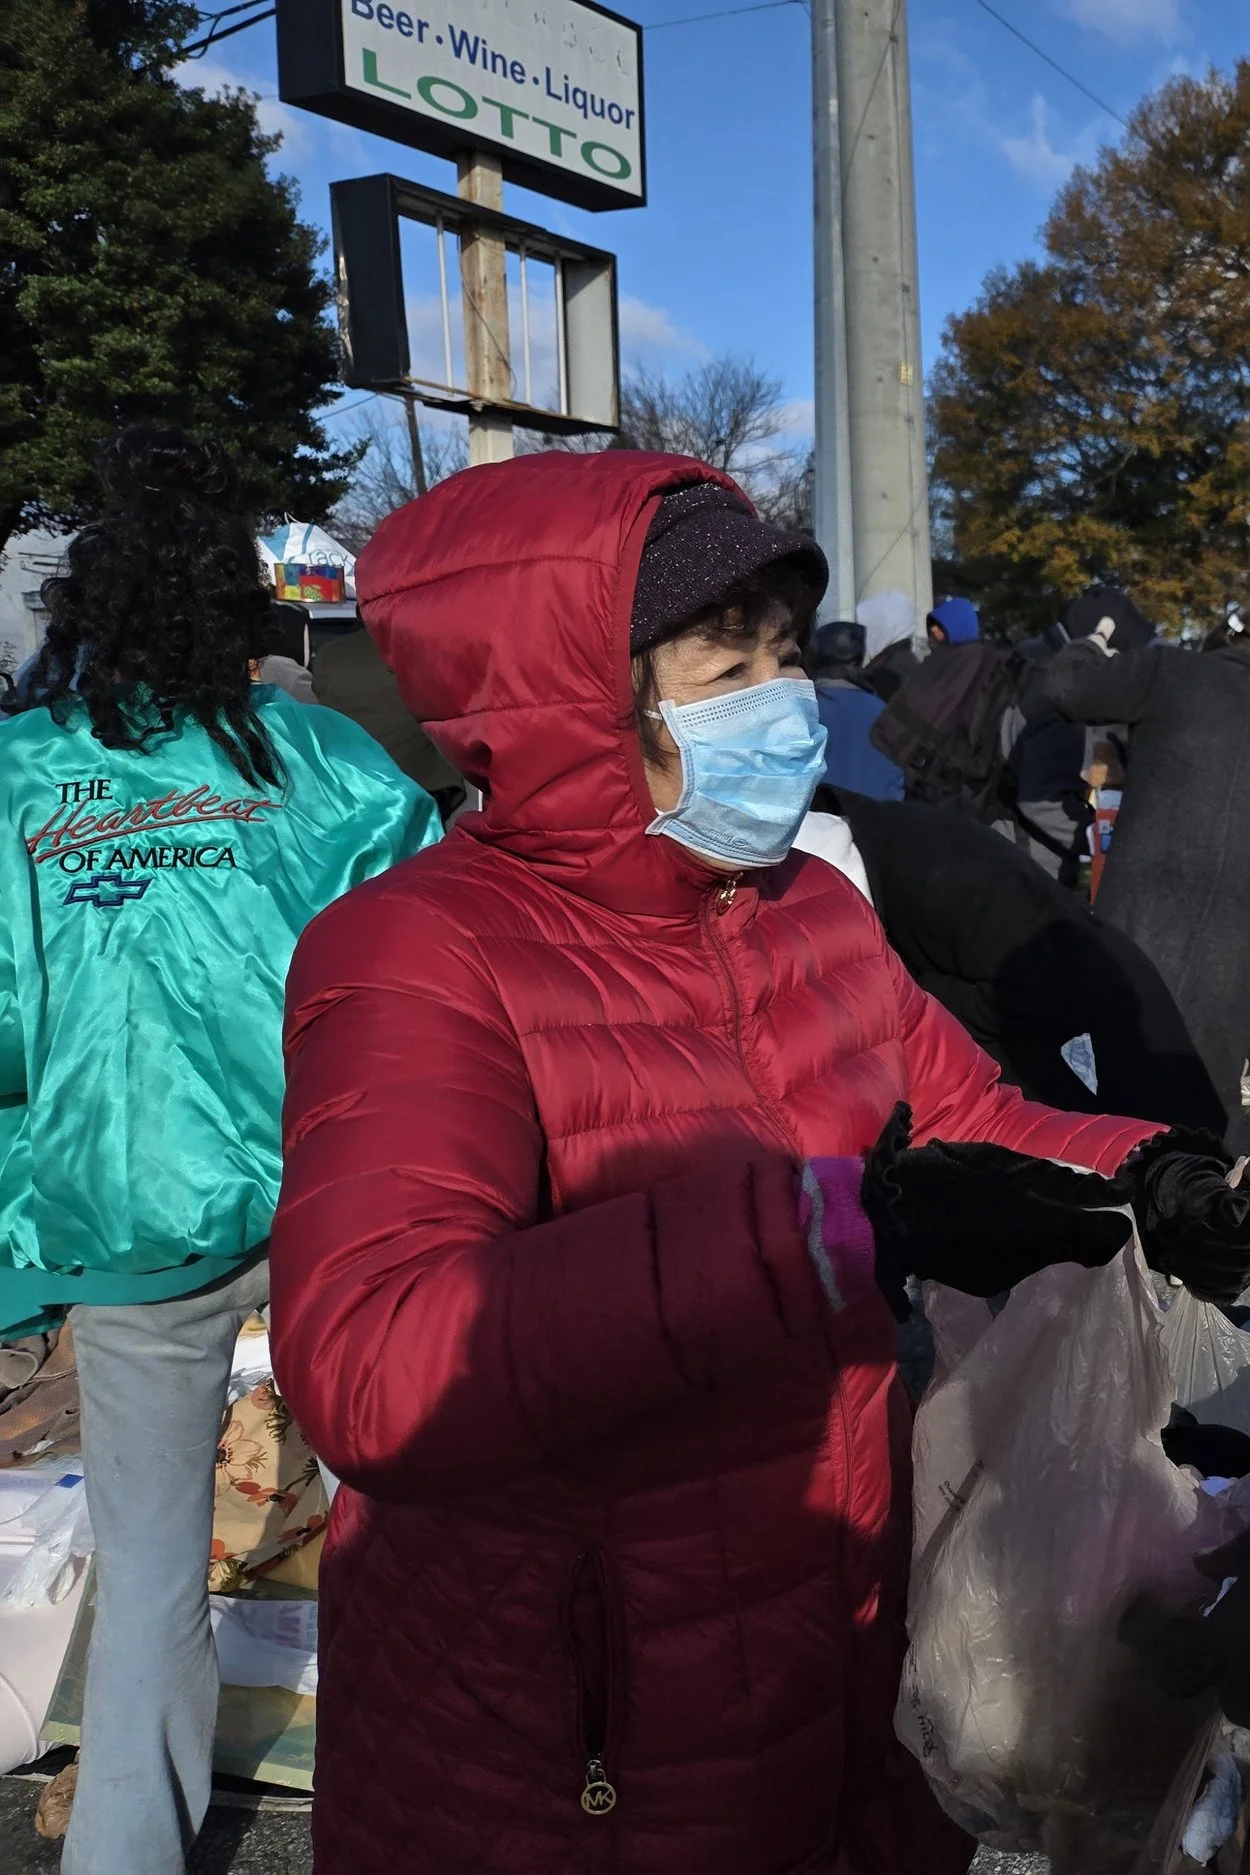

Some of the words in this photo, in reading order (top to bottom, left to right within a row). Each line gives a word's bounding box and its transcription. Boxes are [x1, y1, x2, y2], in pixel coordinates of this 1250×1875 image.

[351, 0, 430, 44] Beer
[448, 24, 526, 85] Wine
[545, 66, 635, 130] Liquor
[362, 48, 632, 180] LOTTO
[55, 779, 113, 804] THE
[26, 784, 284, 857] Heartbeat
[59, 850, 101, 873] OF
[107, 847, 237, 870] AMERICA
[585, 1789, 613, 1808] MK
